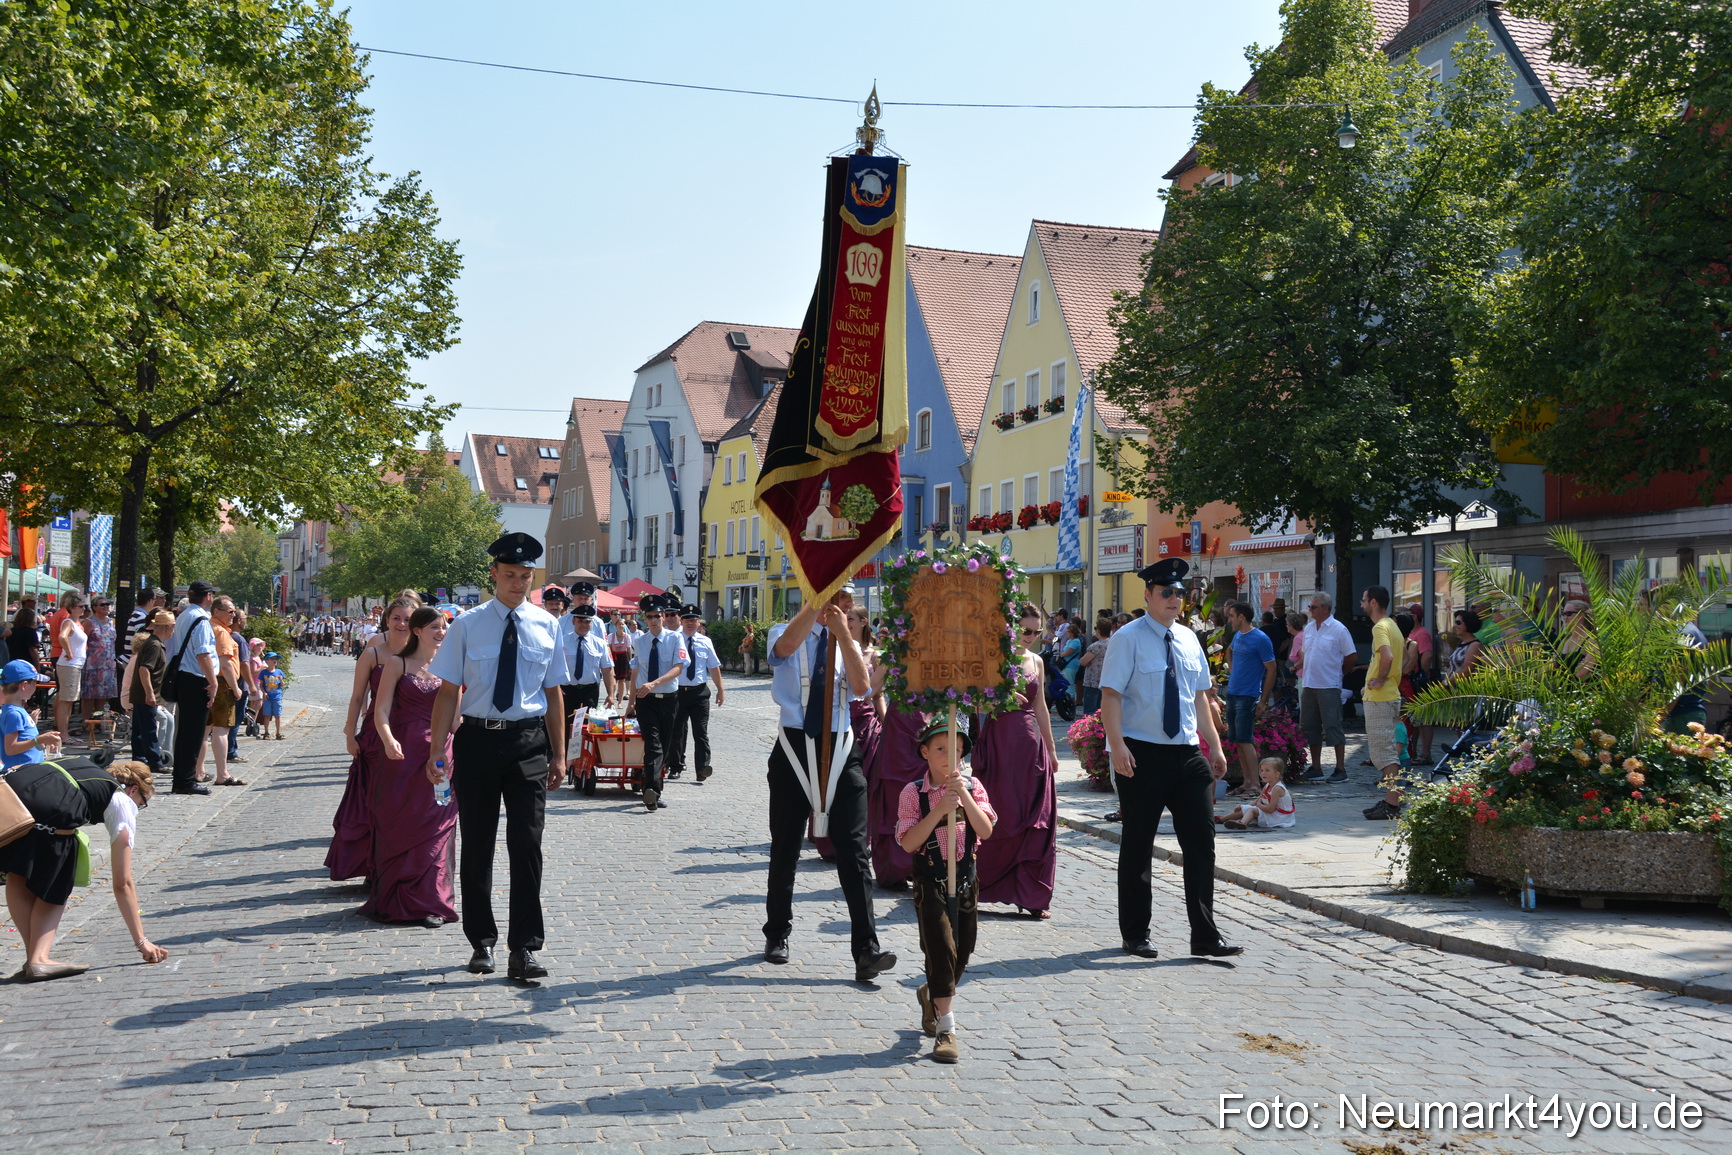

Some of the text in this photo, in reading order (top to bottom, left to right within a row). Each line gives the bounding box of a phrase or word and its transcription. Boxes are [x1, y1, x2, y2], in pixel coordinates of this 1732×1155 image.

[850, 250, 878, 279] 100
[849, 286, 872, 303] Vom
[845, 303, 873, 321] Fest-
[841, 335, 871, 348] und den
[837, 346, 872, 367] Fest-
[835, 395, 864, 413] 1990
[1106, 493, 1121, 501] KINO
[731, 499, 747, 515] HOTEL
[920, 661, 984, 680] HENG
